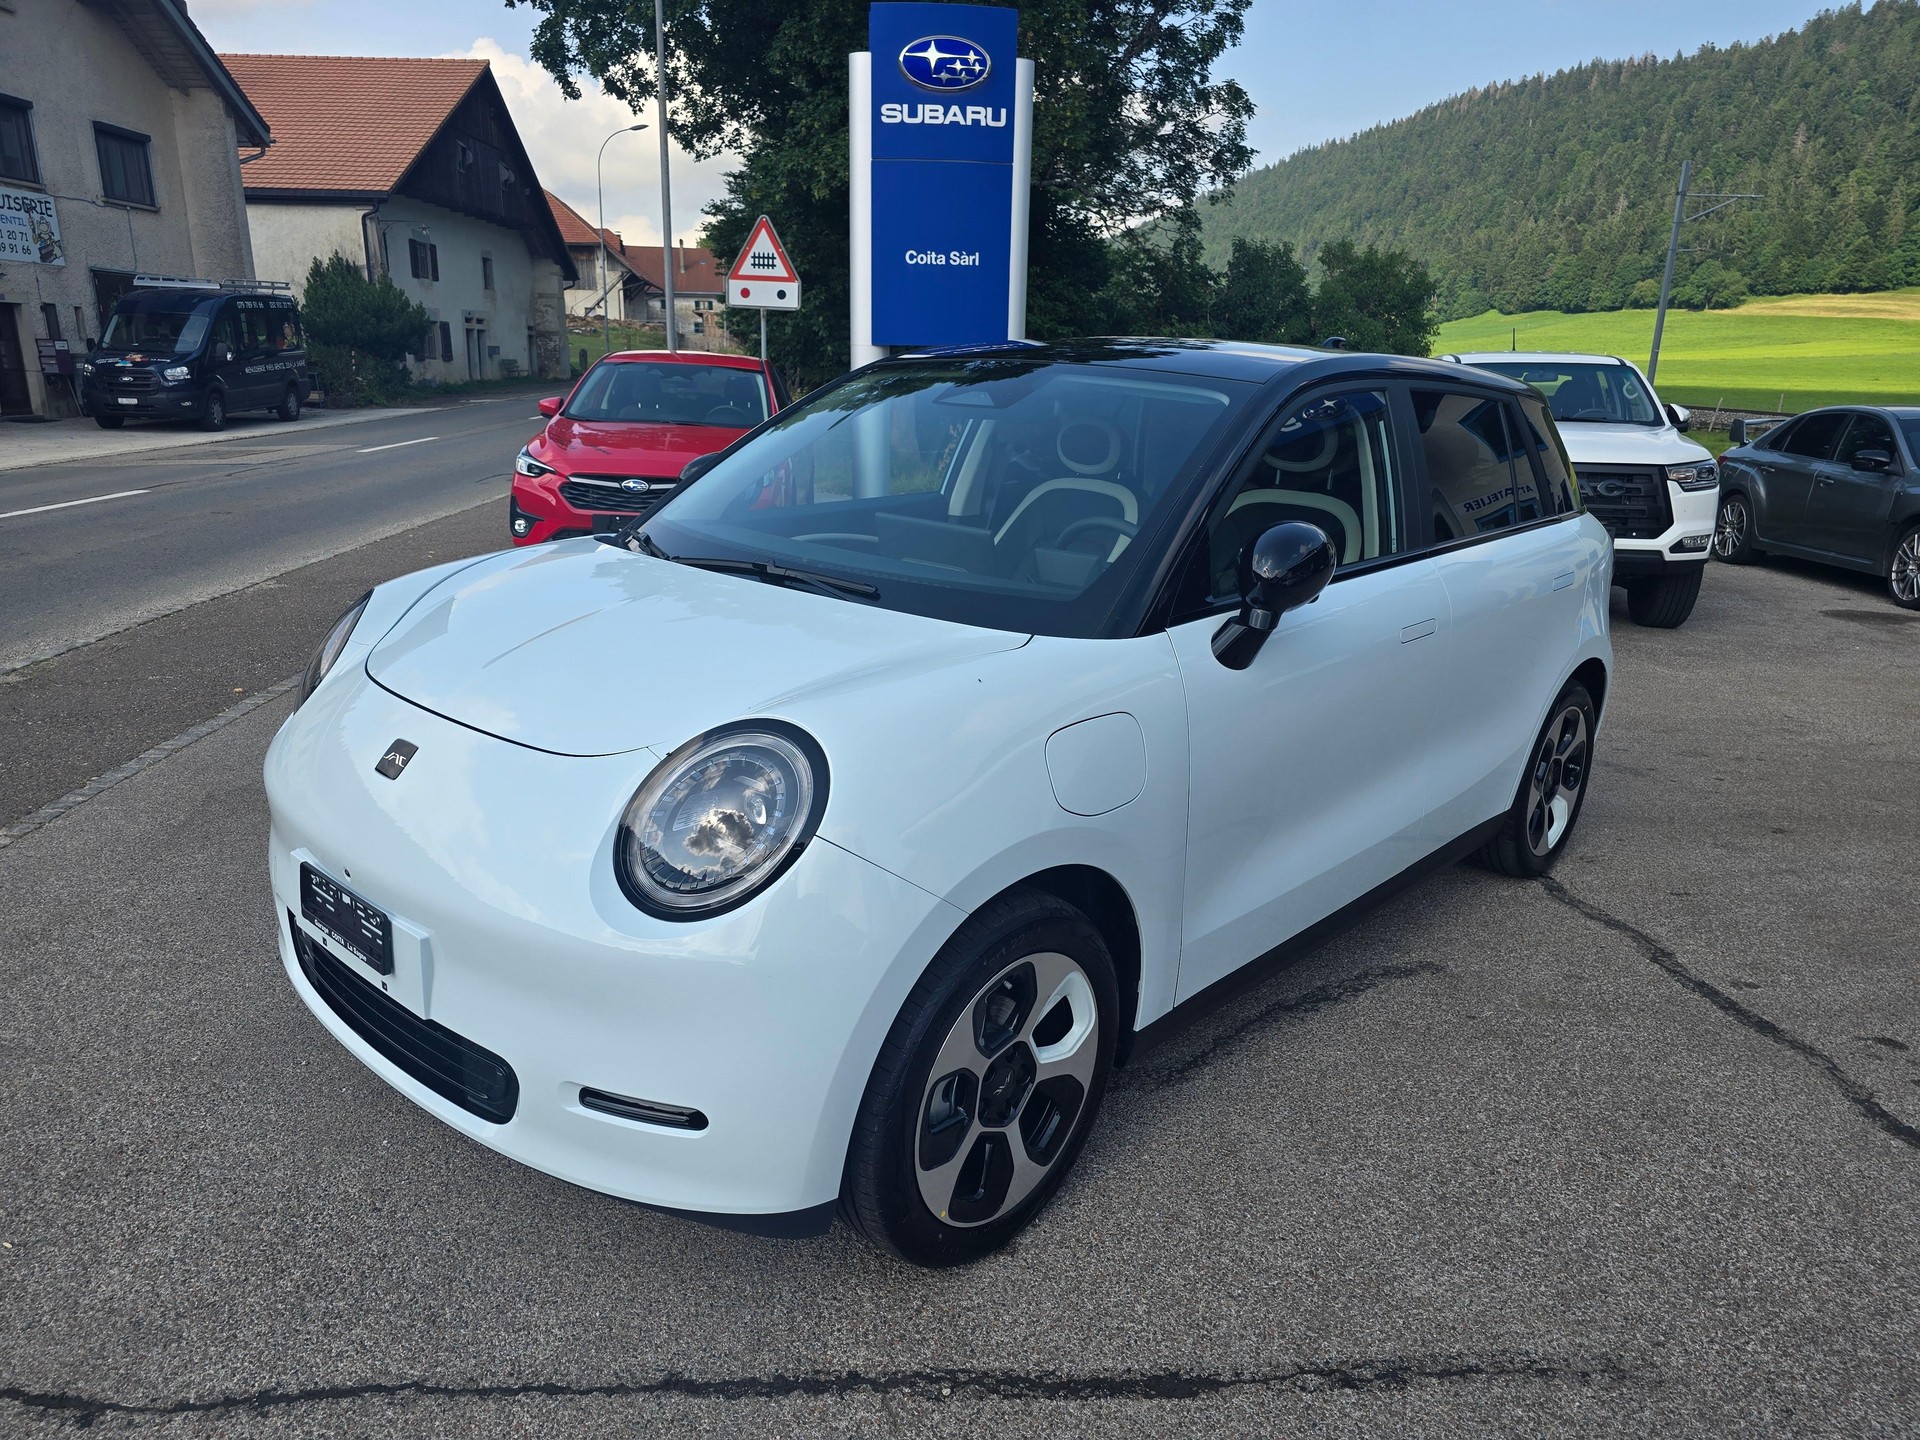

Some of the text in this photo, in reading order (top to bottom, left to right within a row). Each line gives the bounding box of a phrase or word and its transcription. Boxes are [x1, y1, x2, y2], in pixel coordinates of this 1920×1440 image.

[881, 103, 1007, 127] SUBARU
[7, 230, 17, 240] 20
[19, 231, 29, 242] 71
[9, 243, 19, 253] 91
[22, 245, 32, 255] 66
[905, 250, 980, 266] Coita Sàrl
